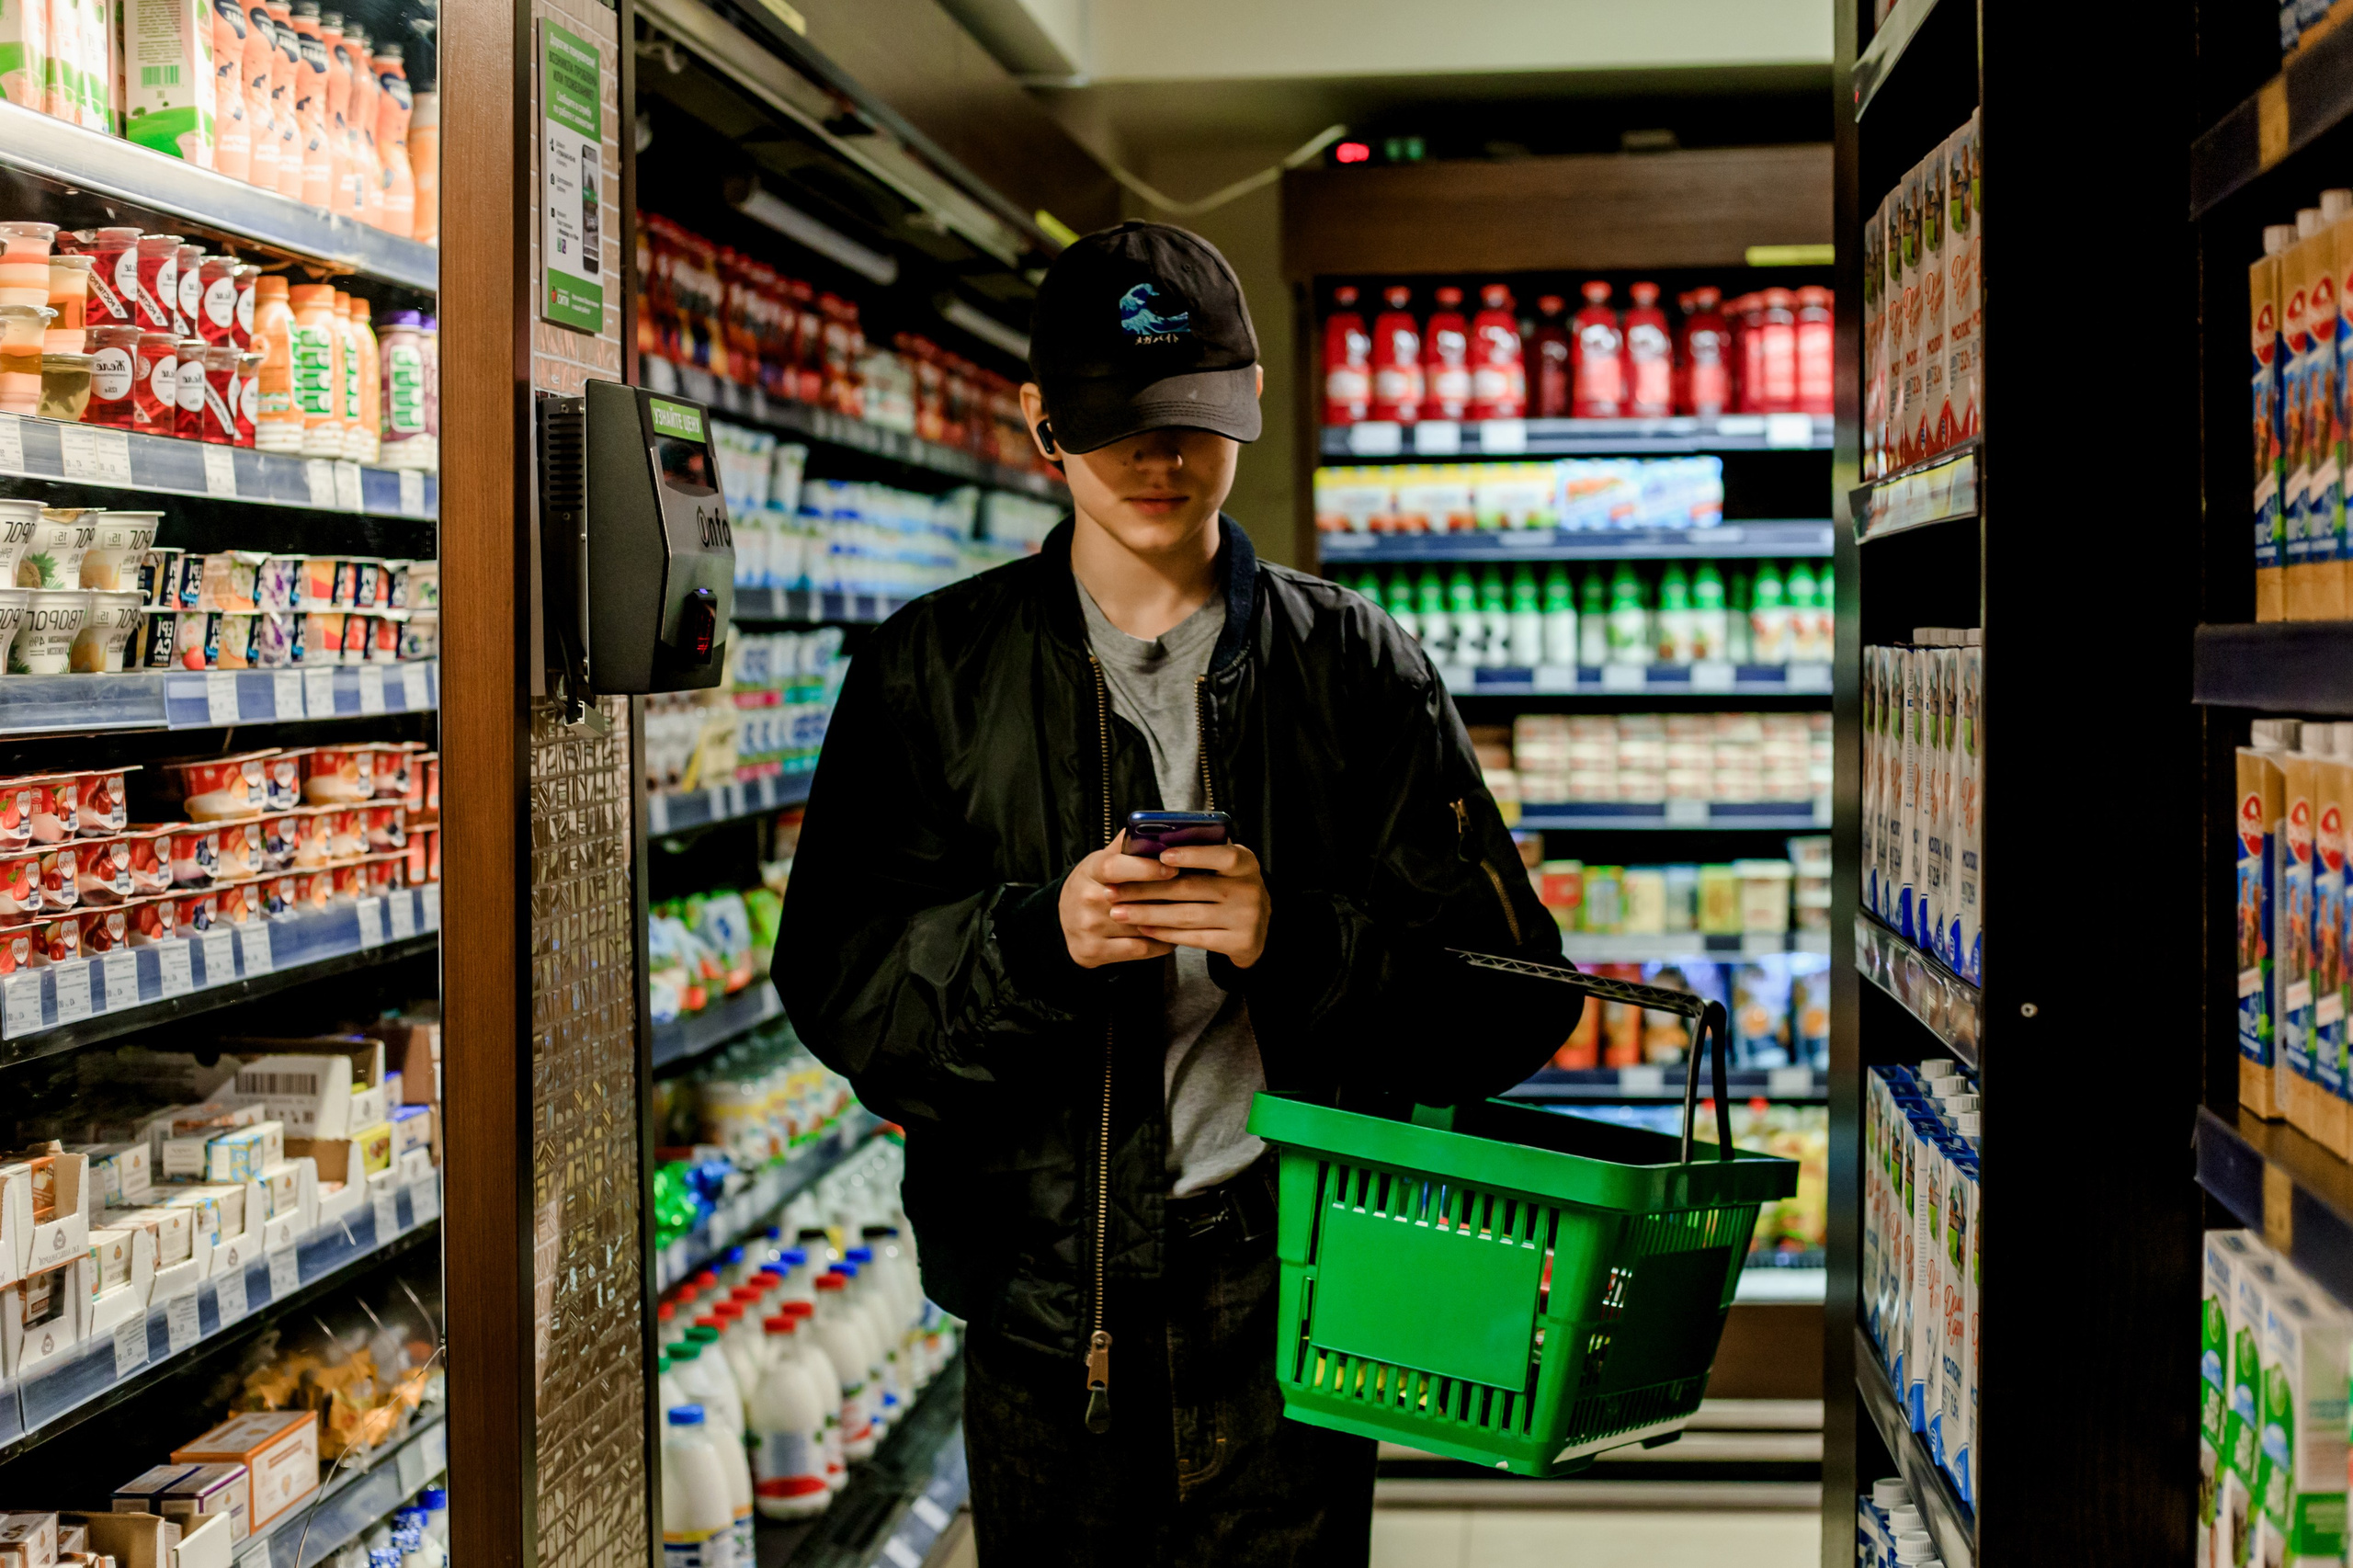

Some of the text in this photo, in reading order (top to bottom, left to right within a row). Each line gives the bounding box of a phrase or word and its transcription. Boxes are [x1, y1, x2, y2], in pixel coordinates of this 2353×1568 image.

[1134, 334, 1179, 346] メガバイト
[1950, 317, 1972, 343] МОЛОК
[653, 406, 700, 435] УЗНАЙТЕ ЦЕНУ
